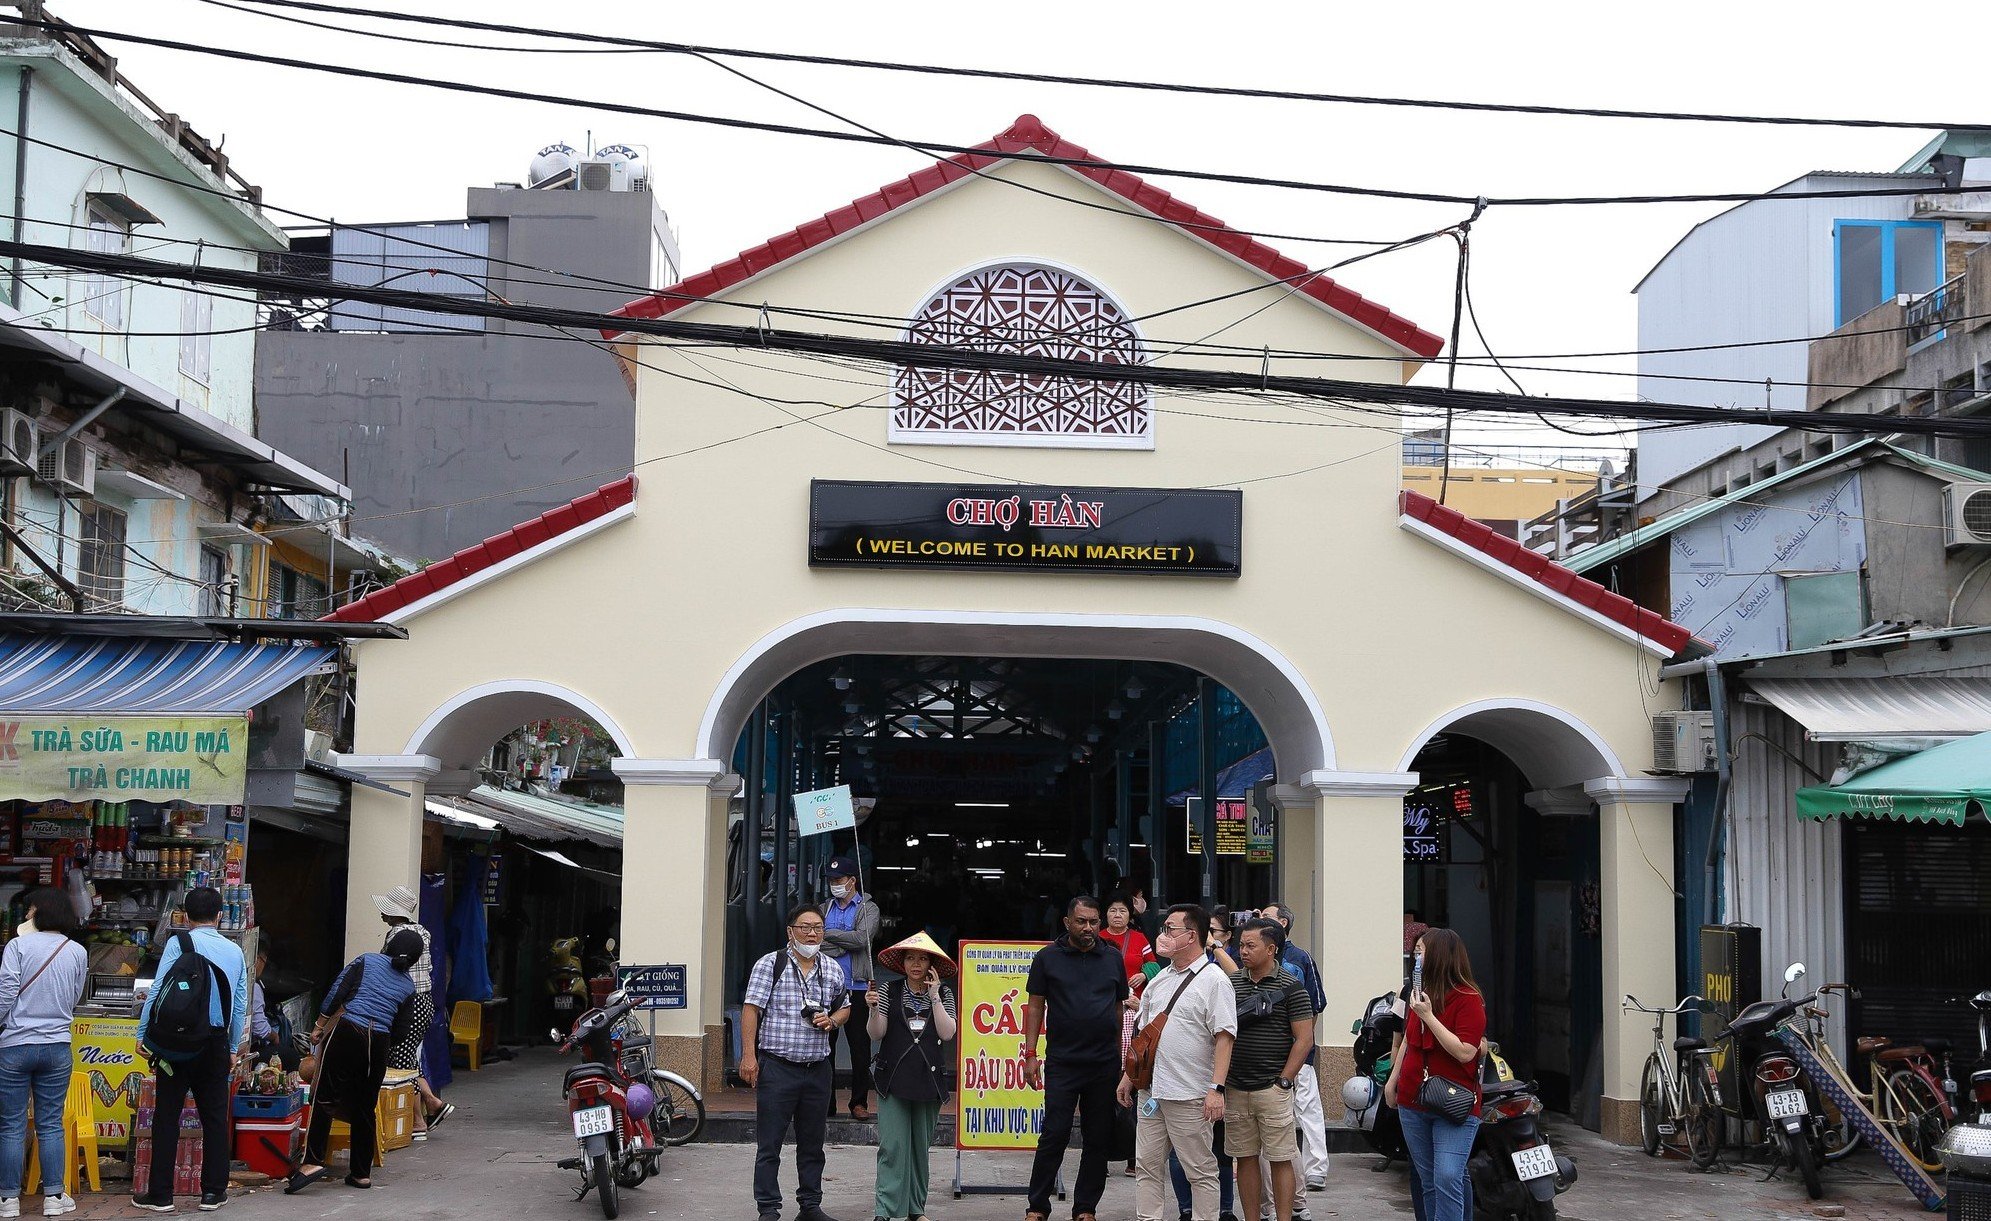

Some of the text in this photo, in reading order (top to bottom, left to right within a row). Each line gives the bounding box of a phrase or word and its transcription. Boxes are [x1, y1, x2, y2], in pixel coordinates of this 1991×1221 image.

[946, 493, 1104, 531] CHỢ HÀN
[870, 540, 986, 557] WELCOME
[992, 543, 1024, 557] TO
[1030, 543, 1079, 559] HAN
[1086, 545, 1182, 562] MARKET
[31, 726, 72, 752] TRÀ
[80, 726, 123, 752] SỮA
[146, 731, 190, 753] RAU
[195, 726, 230, 753] MÁ
[68, 763, 190, 790] TRÀ CHANH
[816, 821, 833, 829] BUS
[1412, 840, 1437, 858] Spa
[74, 1023, 90, 1035] 167
[79, 1045, 134, 1065] Nước
[965, 1048, 1001, 1099] ĐẬU
[1772, 1092, 1799, 1105] 43-X3
[579, 1109, 606, 1123] 43-H8
[1774, 1103, 1801, 1116] 3462
[581, 1120, 607, 1135] 0955
[965, 1107, 981, 1139] TẠI
[984, 1108, 1005, 1134] KHU
[1008, 1106, 1028, 1139] VỰC
[1519, 1159, 1555, 1178] 519.20
